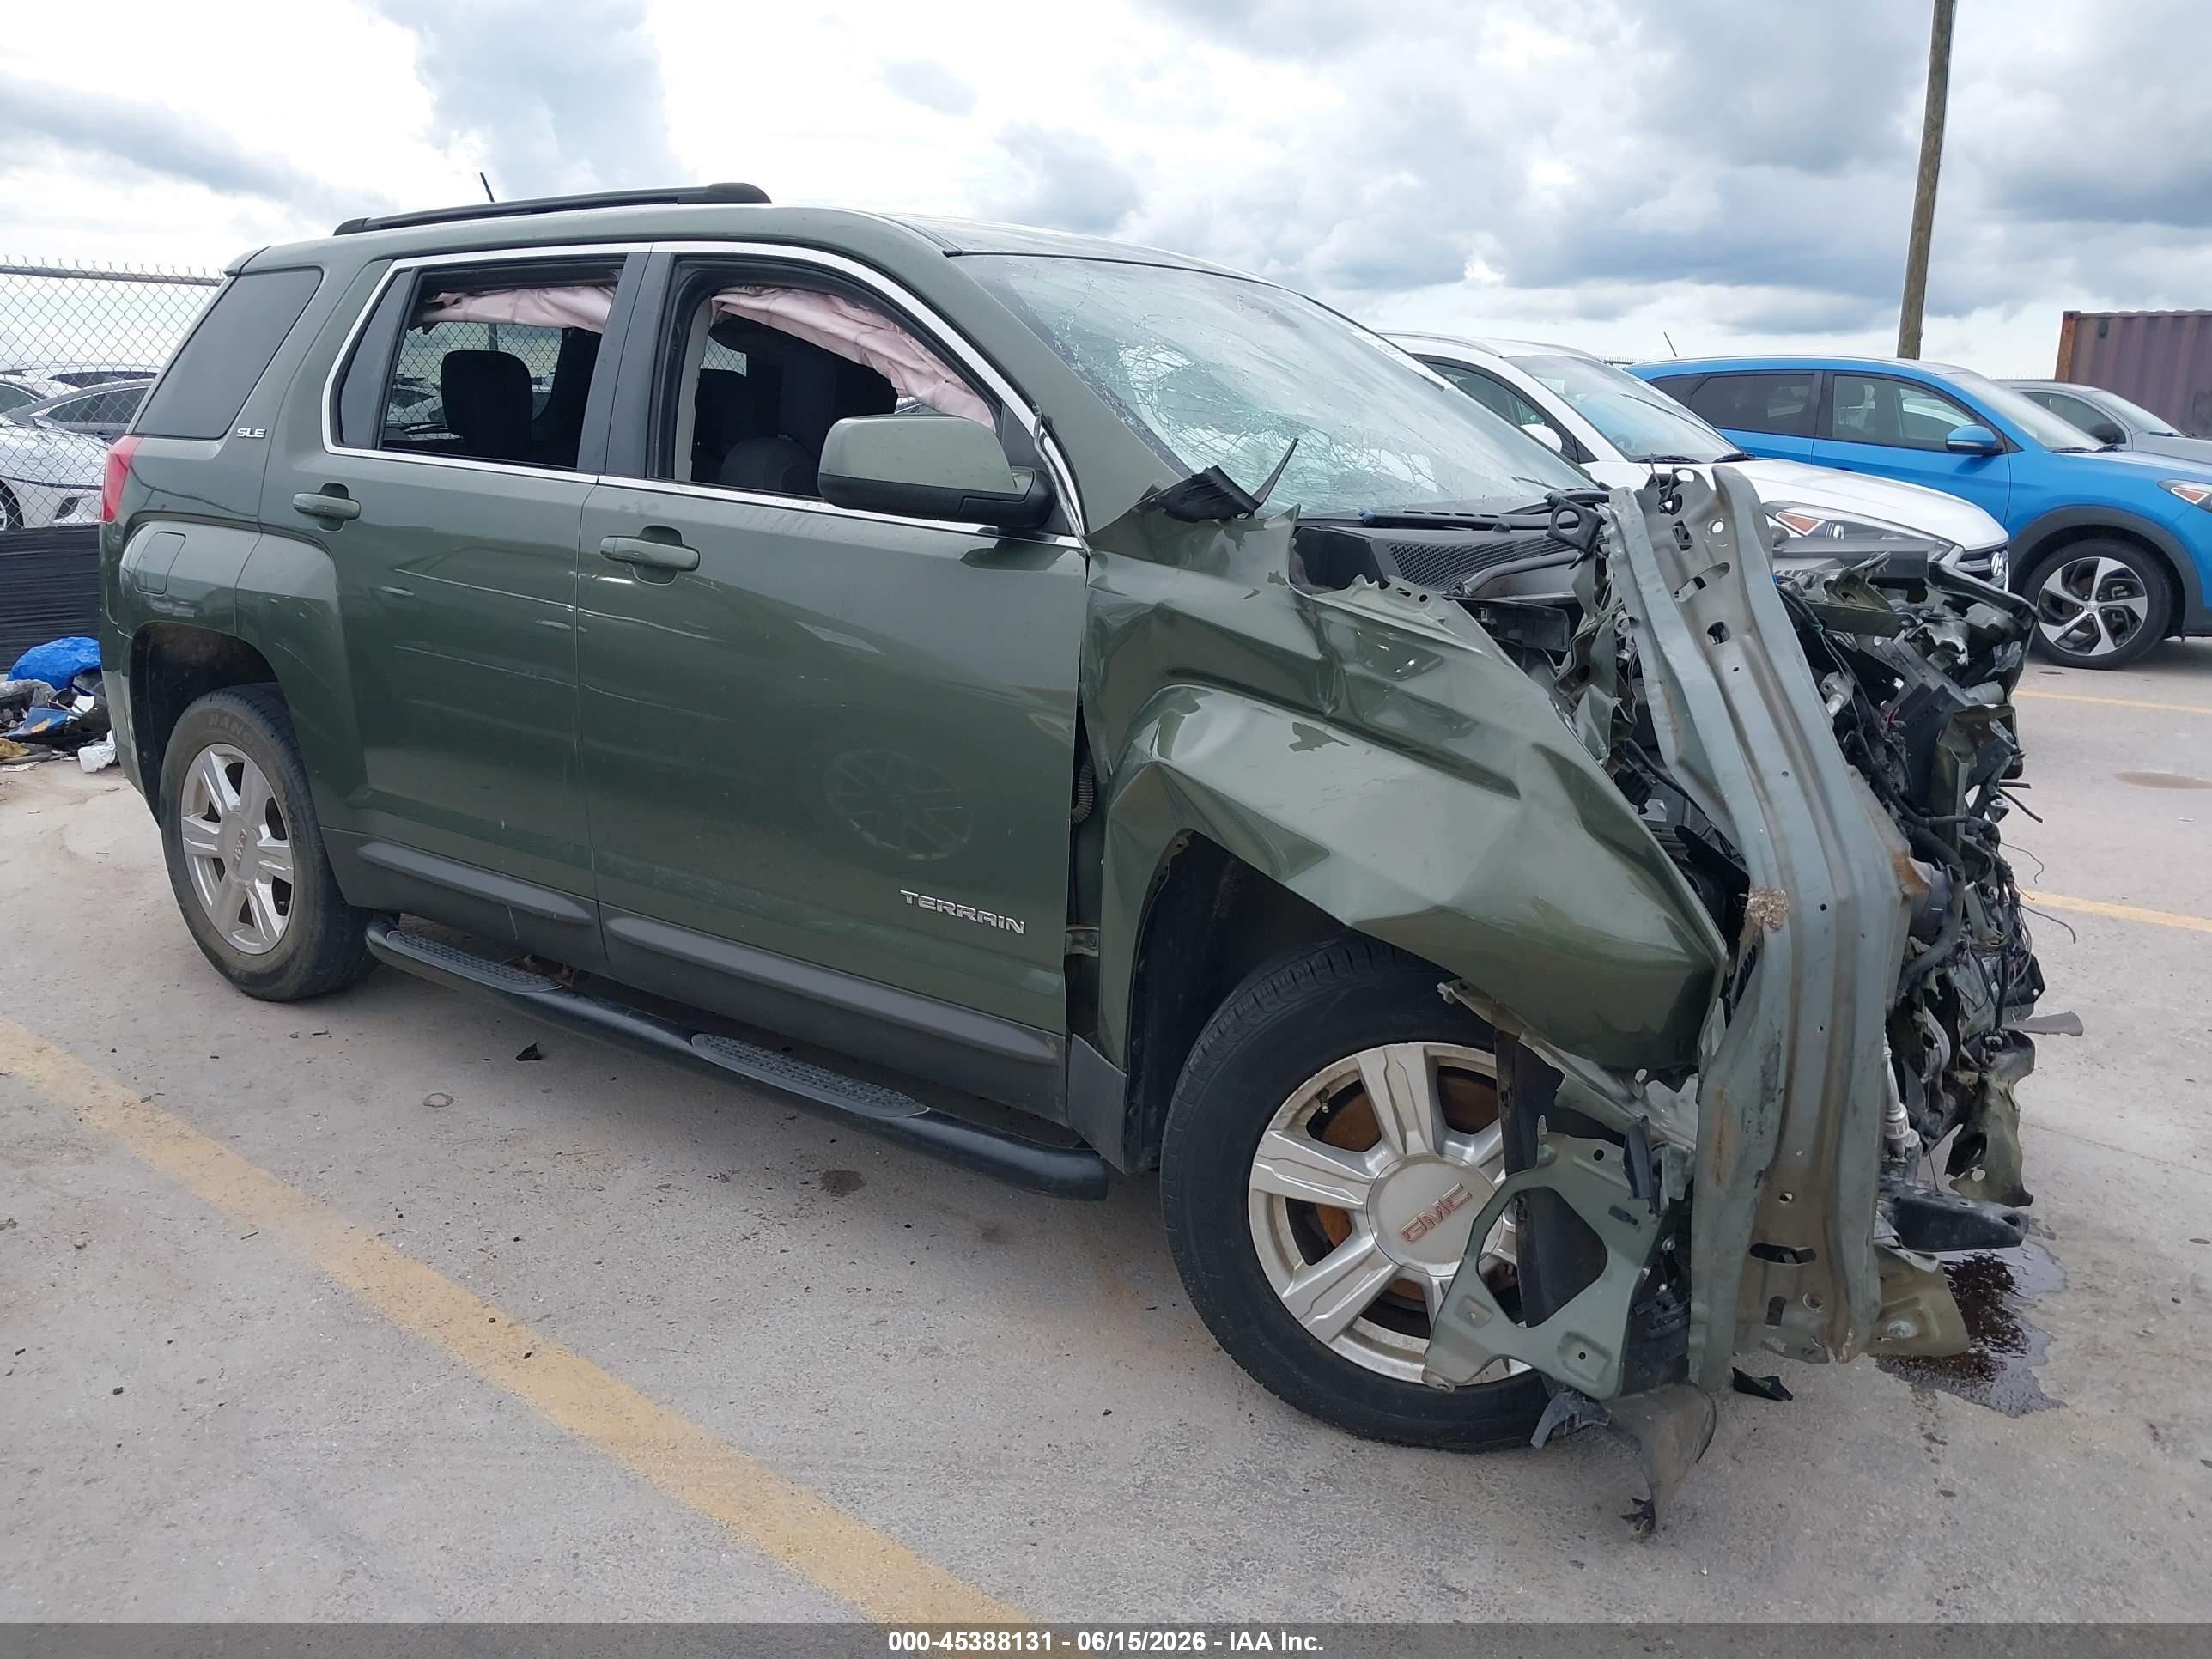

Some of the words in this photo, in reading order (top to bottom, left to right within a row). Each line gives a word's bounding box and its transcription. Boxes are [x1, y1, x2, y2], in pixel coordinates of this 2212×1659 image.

[235, 428, 266, 438] SLE
[899, 889, 1025, 934] TERRAIN
[1401, 1182, 1473, 1243] GMC
